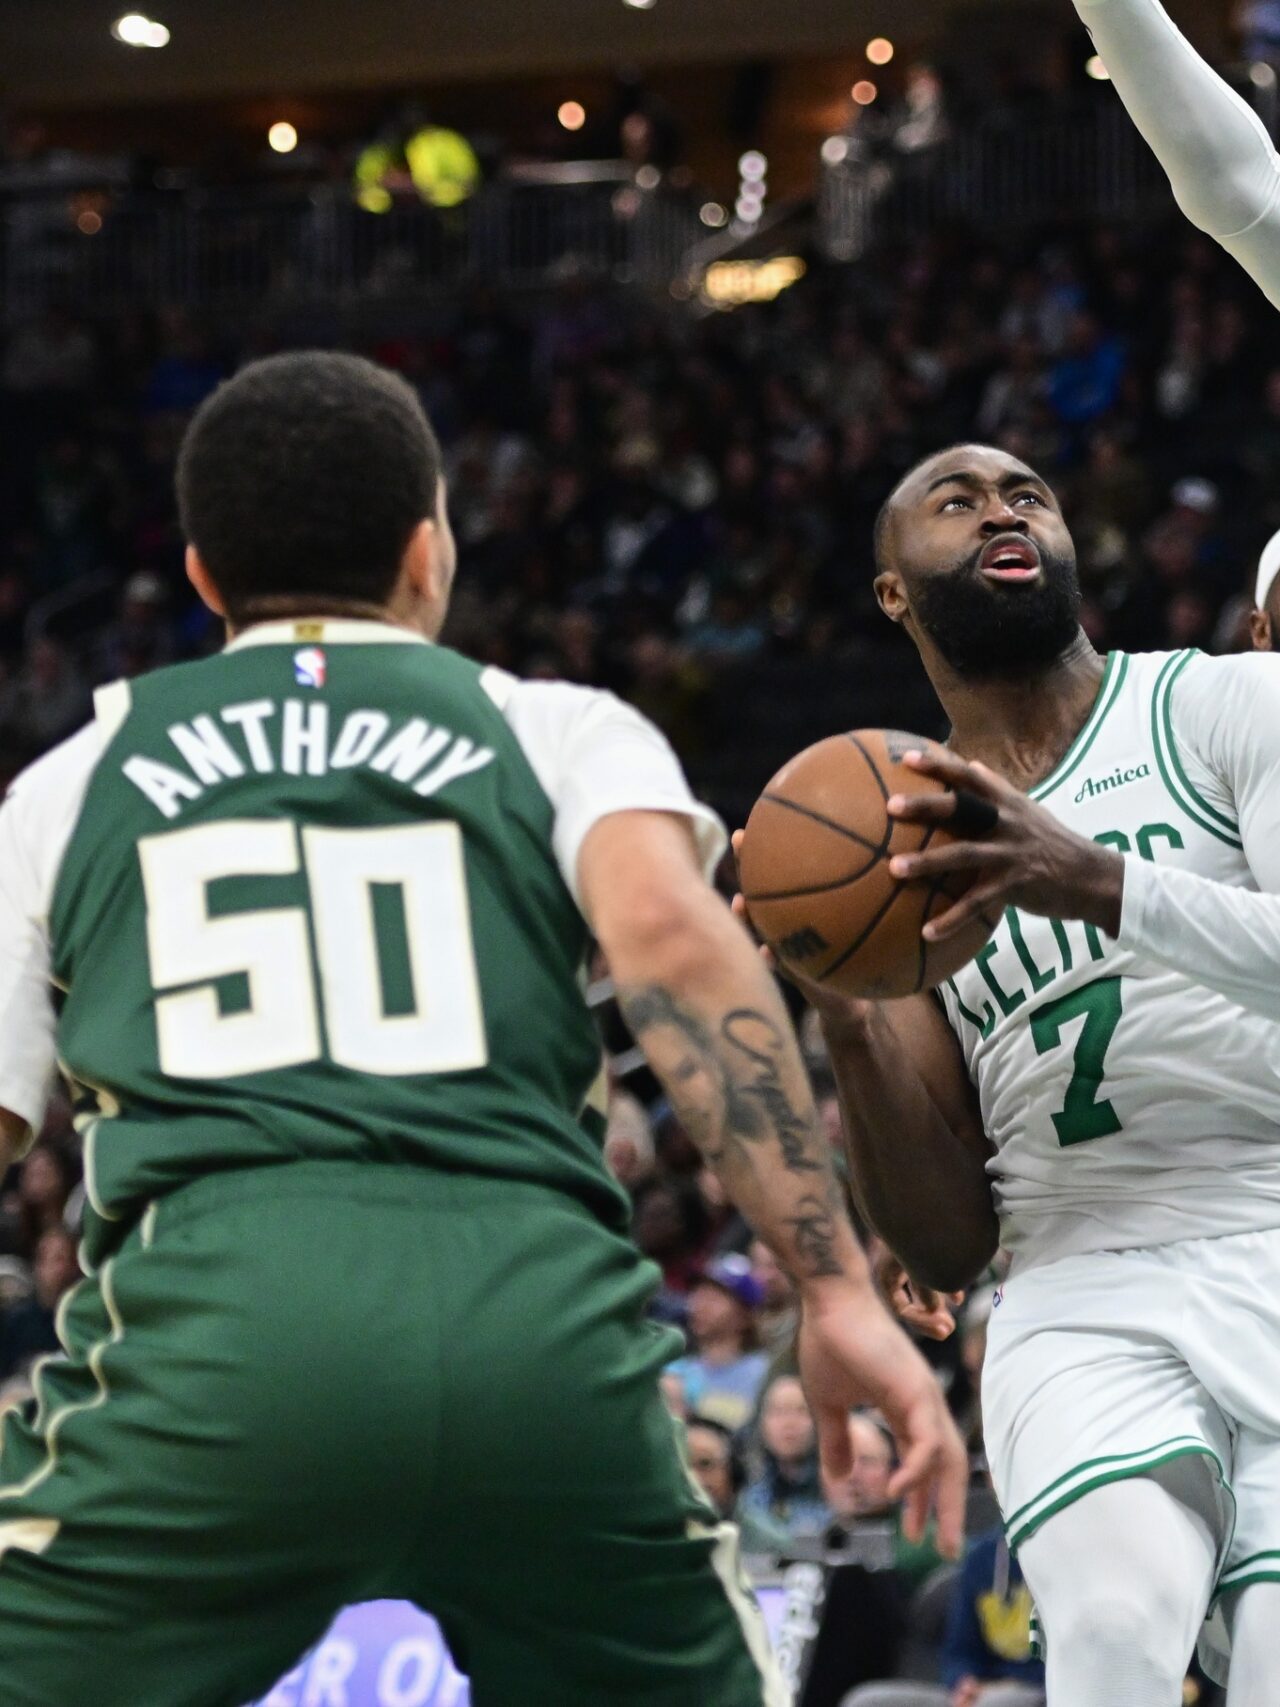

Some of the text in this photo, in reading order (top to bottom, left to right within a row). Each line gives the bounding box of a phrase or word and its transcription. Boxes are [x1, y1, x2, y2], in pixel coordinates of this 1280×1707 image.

[121, 698, 496, 819] ANTHONY
[1074, 764, 1151, 803] Amica
[137, 817, 489, 1079] 50
[1029, 975, 1123, 1147] 7
